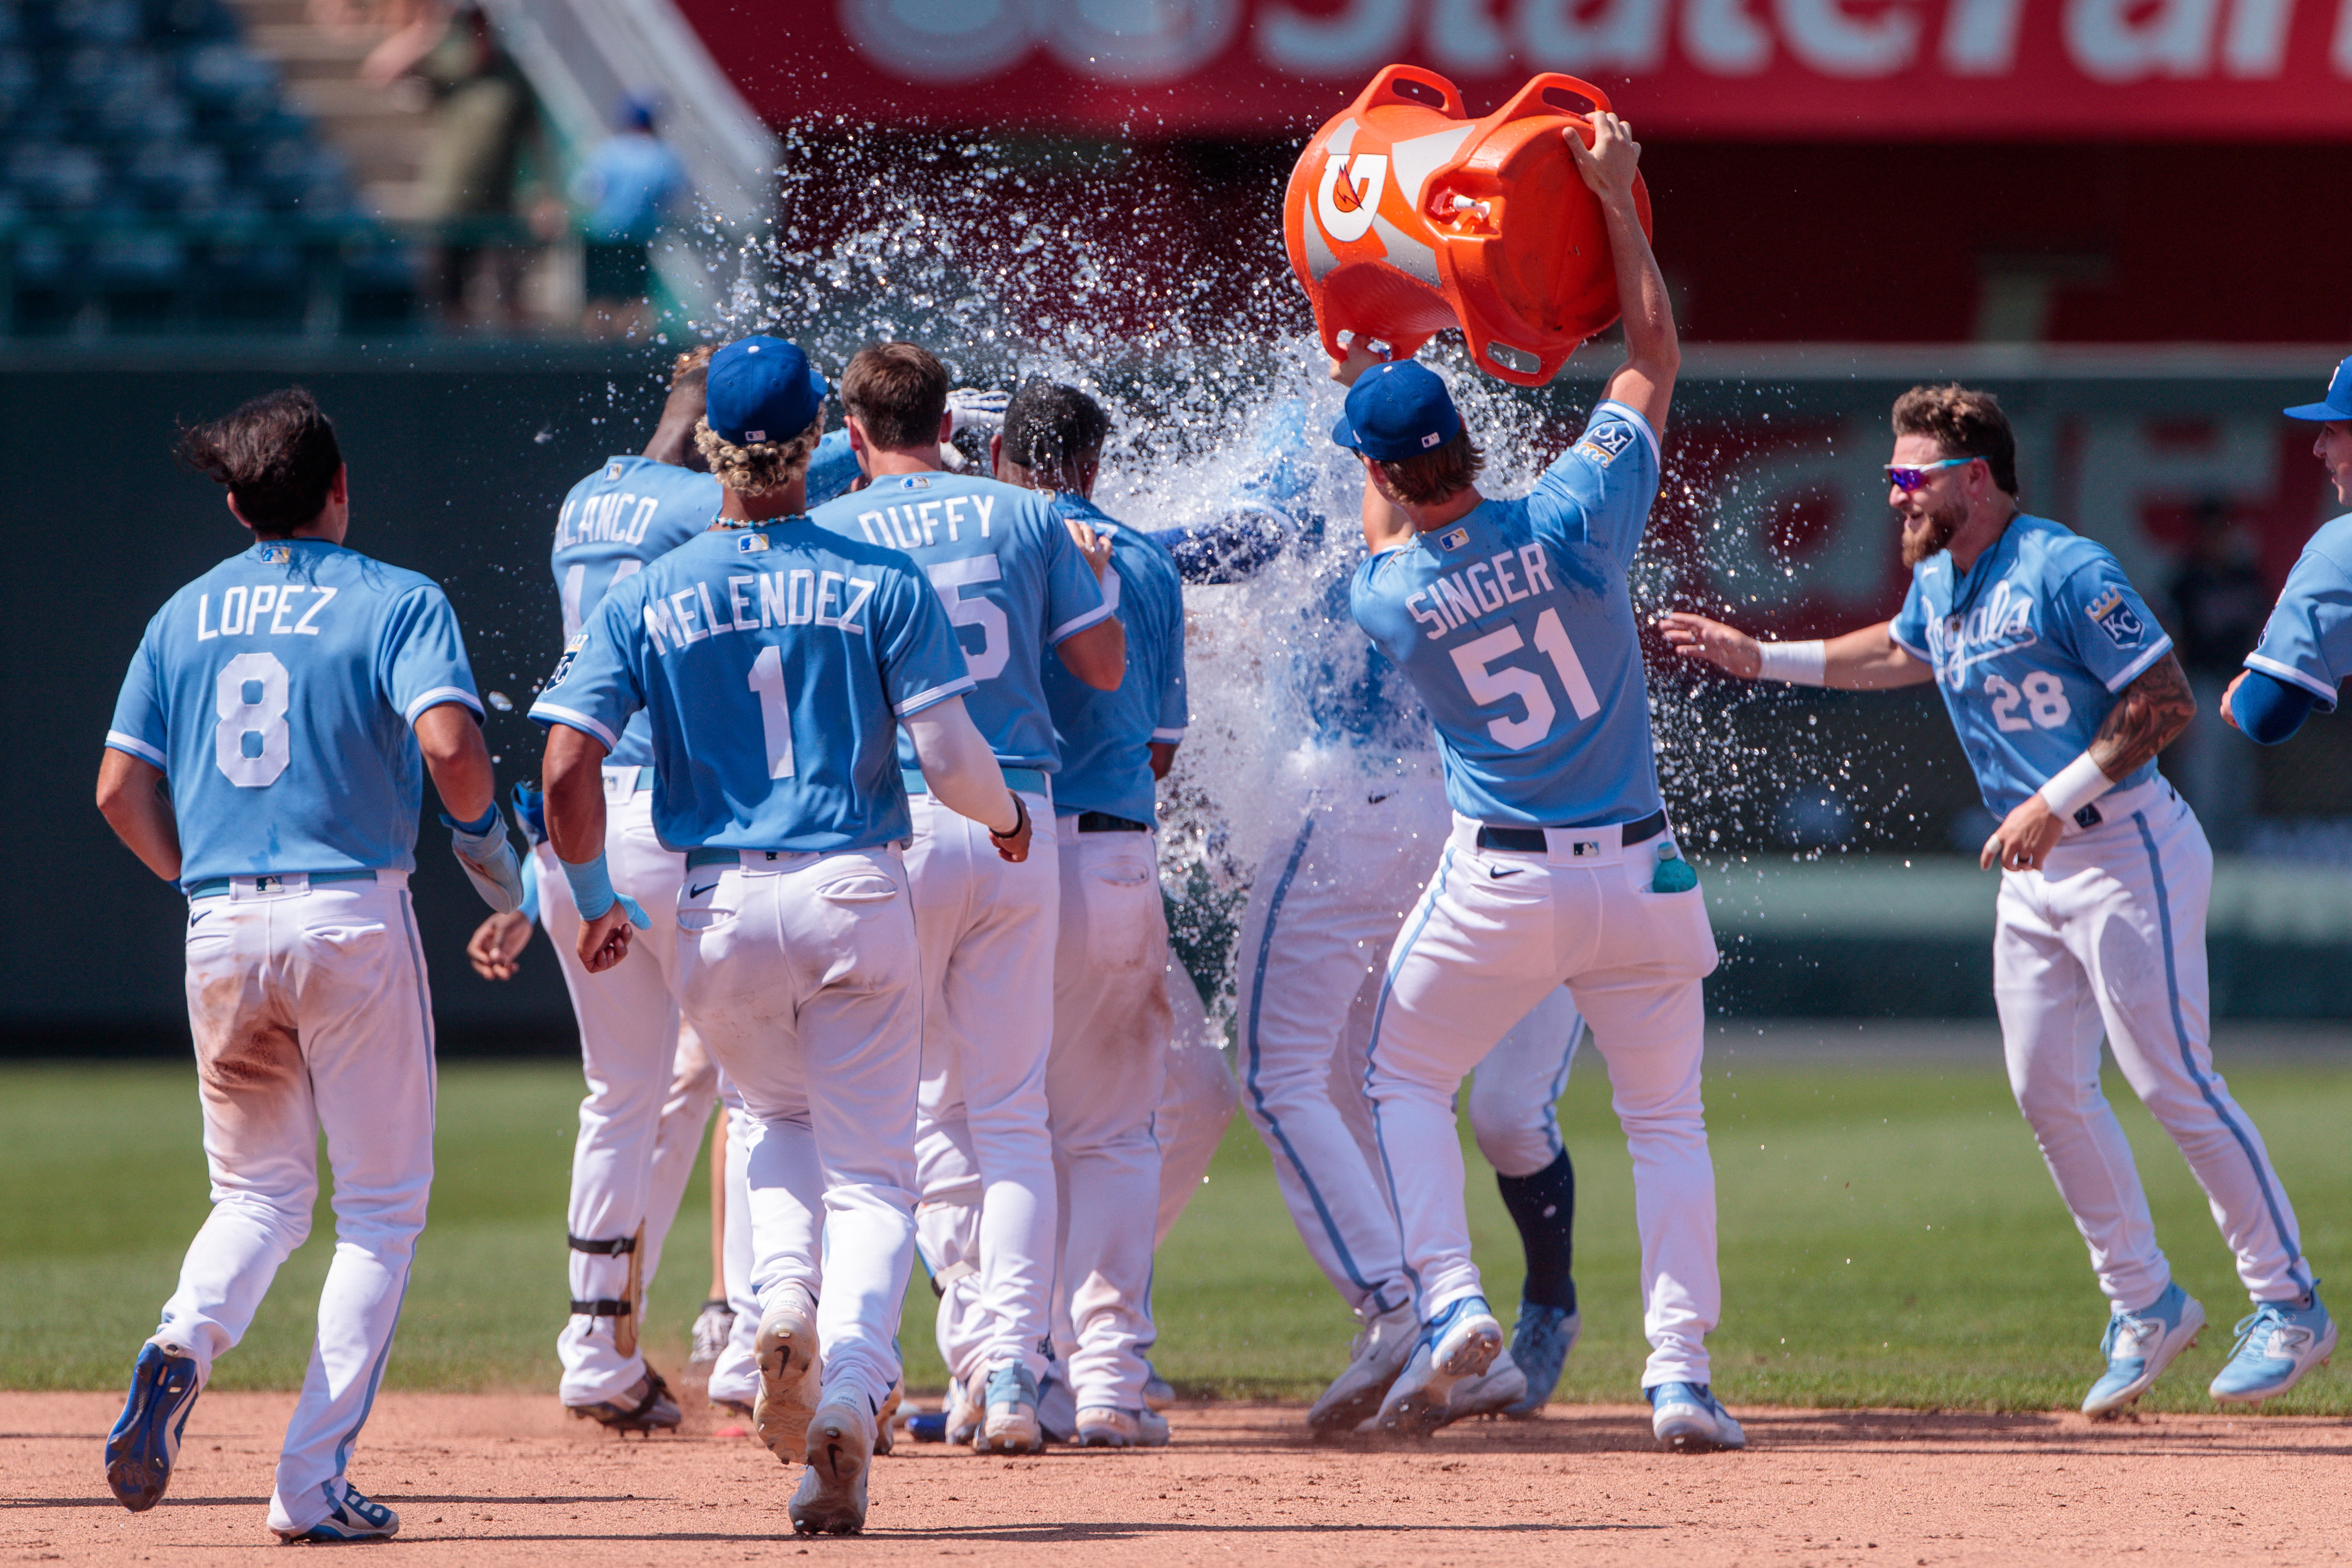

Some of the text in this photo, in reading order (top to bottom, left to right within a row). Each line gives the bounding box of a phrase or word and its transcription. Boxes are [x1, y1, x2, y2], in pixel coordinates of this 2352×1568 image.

[1317, 153, 1388, 242] G
[1594, 424, 1628, 454] KC
[858, 495, 995, 550] DUFFY
[198, 585, 337, 642] LOPEZ
[562, 560, 642, 649] 1
[644, 569, 876, 656] MELENDEZ
[1405, 543, 1554, 640] SINGER
[2102, 610, 2141, 641] KC
[216, 652, 290, 787] 8
[748, 646, 795, 780] 1
[1449, 607, 1601, 751] 51
[1984, 671, 2071, 732] 28
